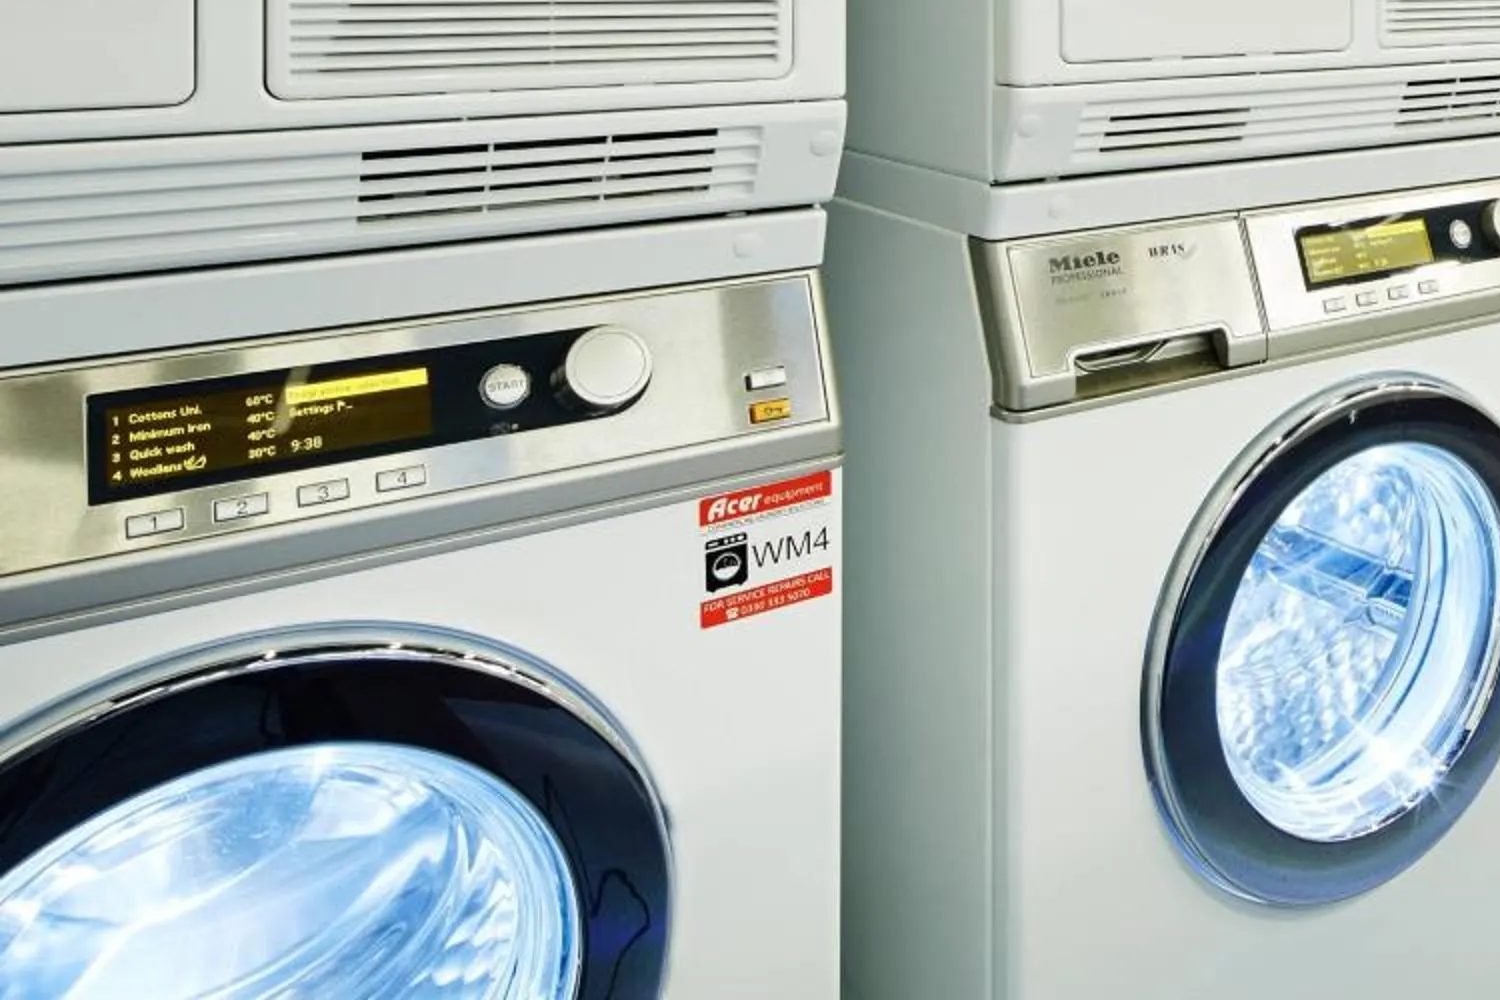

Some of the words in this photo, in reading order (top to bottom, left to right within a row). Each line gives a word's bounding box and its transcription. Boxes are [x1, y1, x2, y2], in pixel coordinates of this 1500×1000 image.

[1048, 251, 1121, 274] Miele
[487, 378, 525, 393] START
[112, 416, 119, 427] 1
[128, 408, 177, 425] Cottons
[289, 404, 335, 418] Settings
[111, 434, 121, 445] 2
[129, 426, 185, 443] Minimum
[111, 453, 121, 463] 3
[129, 446, 162, 462] Quick
[165, 441, 195, 456] wash
[112, 471, 122, 481] 4
[129, 464, 183, 479] Woollens
[396, 471, 408, 486] 4
[318, 485, 330, 501] 3
[236, 501, 249, 516] 2
[707, 493, 762, 523] Acer
[764, 482, 824, 505] equipment
[151, 517, 158, 530] 1
[751, 525, 831, 568] WM4
[703, 599, 726, 613] FOR
[725, 589, 766, 607] SERVICE
[767, 578, 808, 594] REPAIRS
[808, 568, 831, 584] CALL
